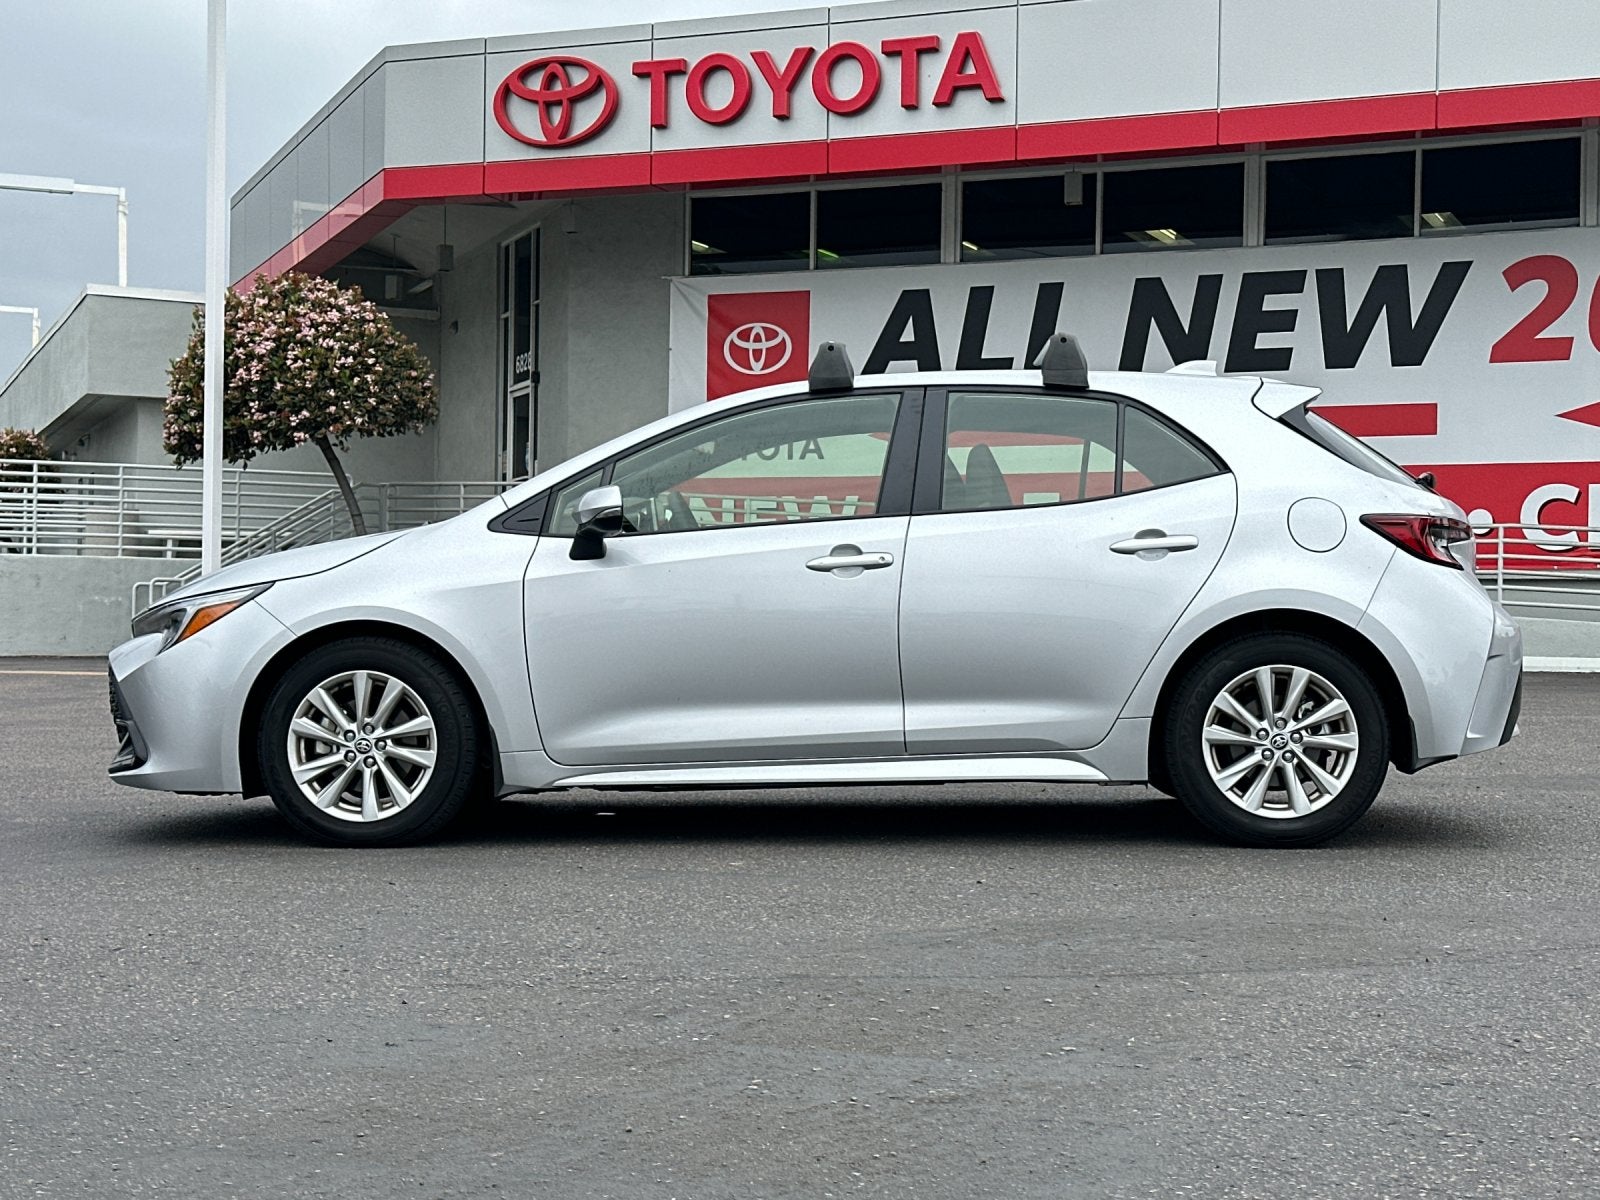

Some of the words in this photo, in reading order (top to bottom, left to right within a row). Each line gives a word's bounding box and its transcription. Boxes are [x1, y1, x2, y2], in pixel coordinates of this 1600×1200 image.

[632, 31, 1005, 129] TOYOTA
[861, 281, 1064, 375] ALL
[1119, 260, 1474, 373] NEW
[1489, 254, 1600, 364] 2
[1520, 483, 1600, 551] C
